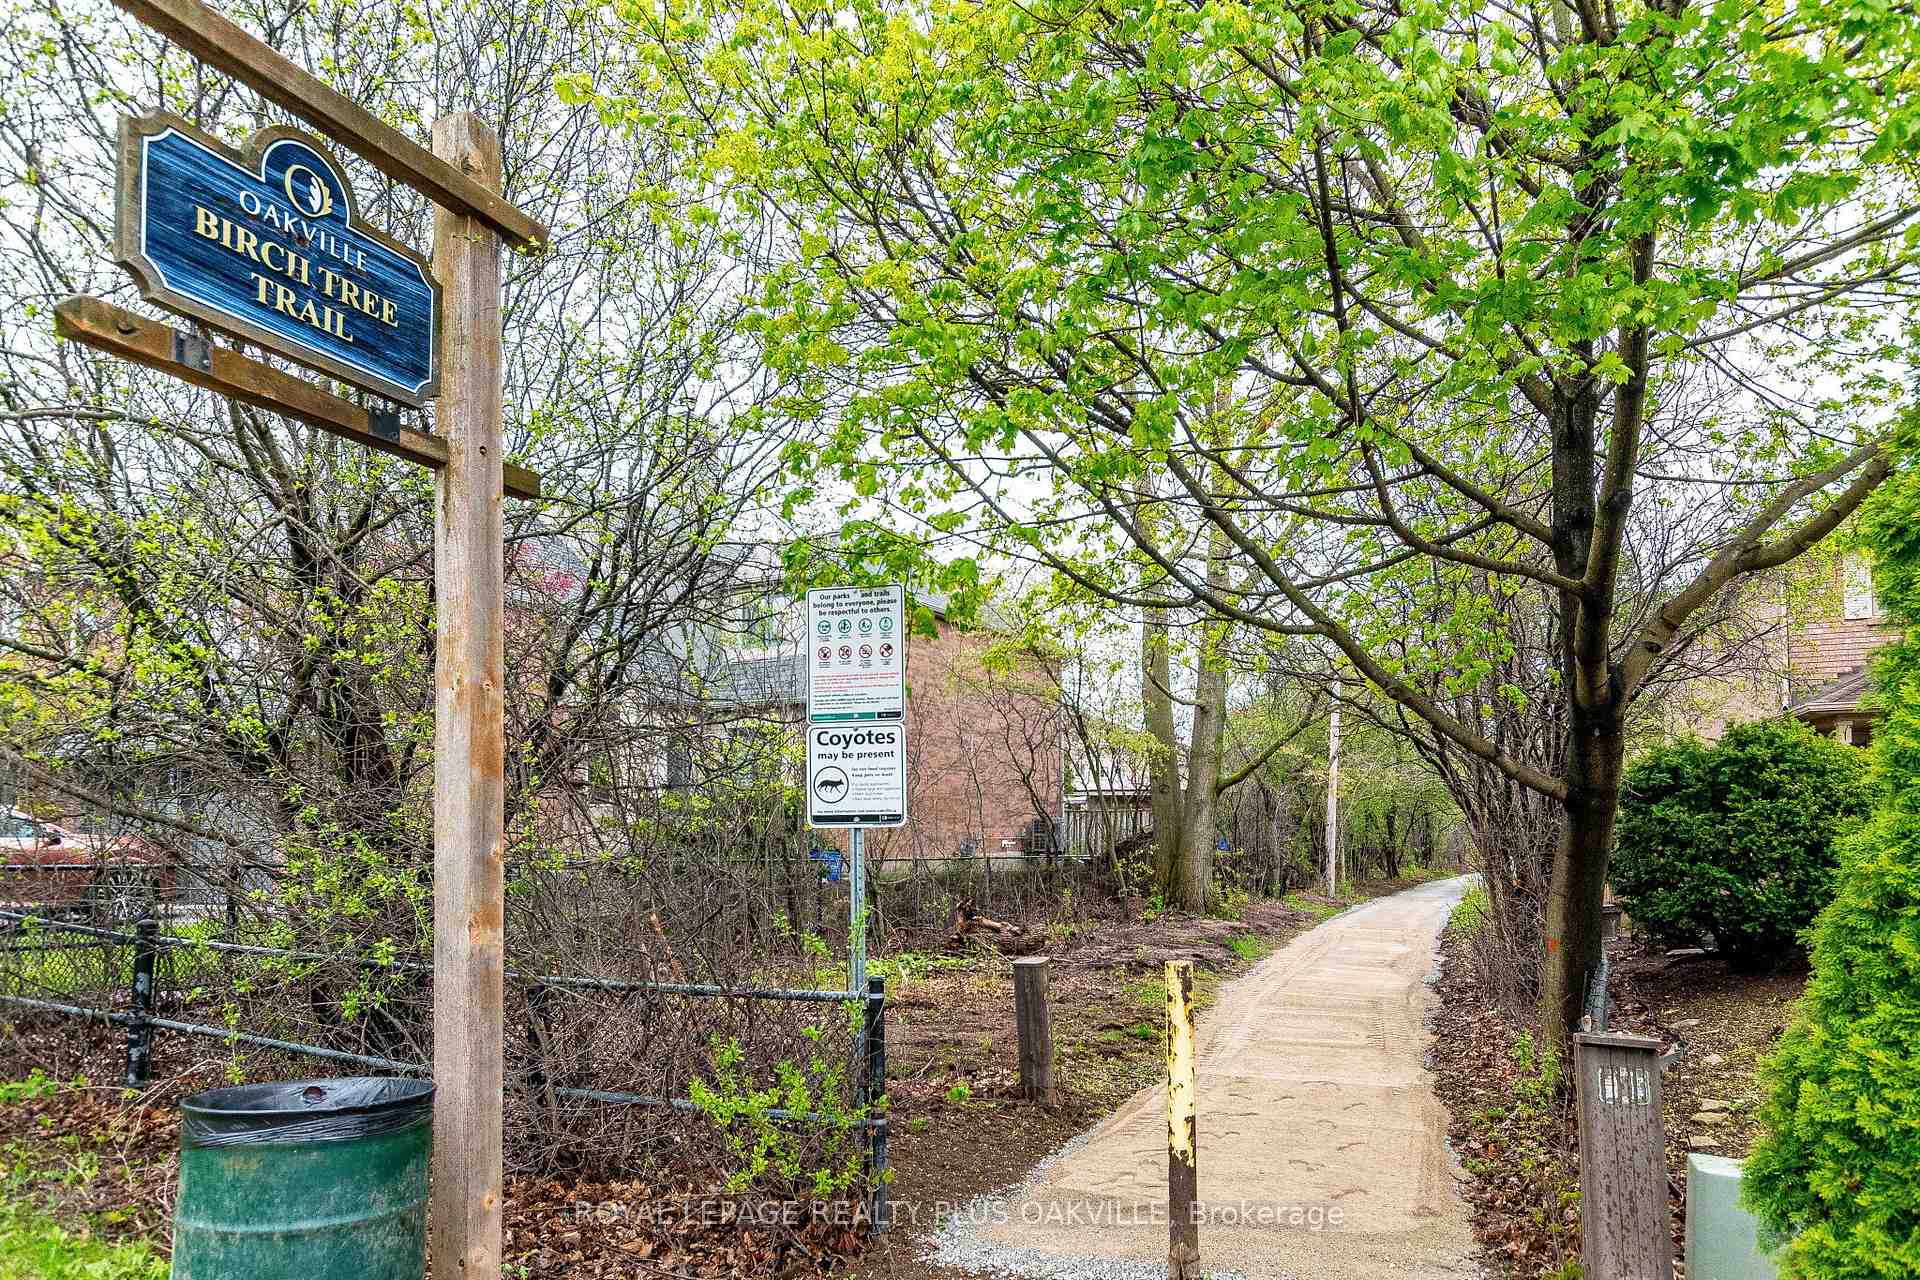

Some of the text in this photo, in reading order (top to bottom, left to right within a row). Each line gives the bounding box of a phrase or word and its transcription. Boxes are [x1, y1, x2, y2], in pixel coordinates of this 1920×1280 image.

[239, 190, 368, 272] OAKVILLE
[193, 205, 399, 328] BIRCH TREE
[251, 272, 353, 342] TRAIL
[833, 592, 850, 601] parks
[877, 598, 896, 606] please
[828, 608, 860, 616] respectful
[817, 730, 895, 750] Coyotes
[818, 750, 895, 760] may be present
